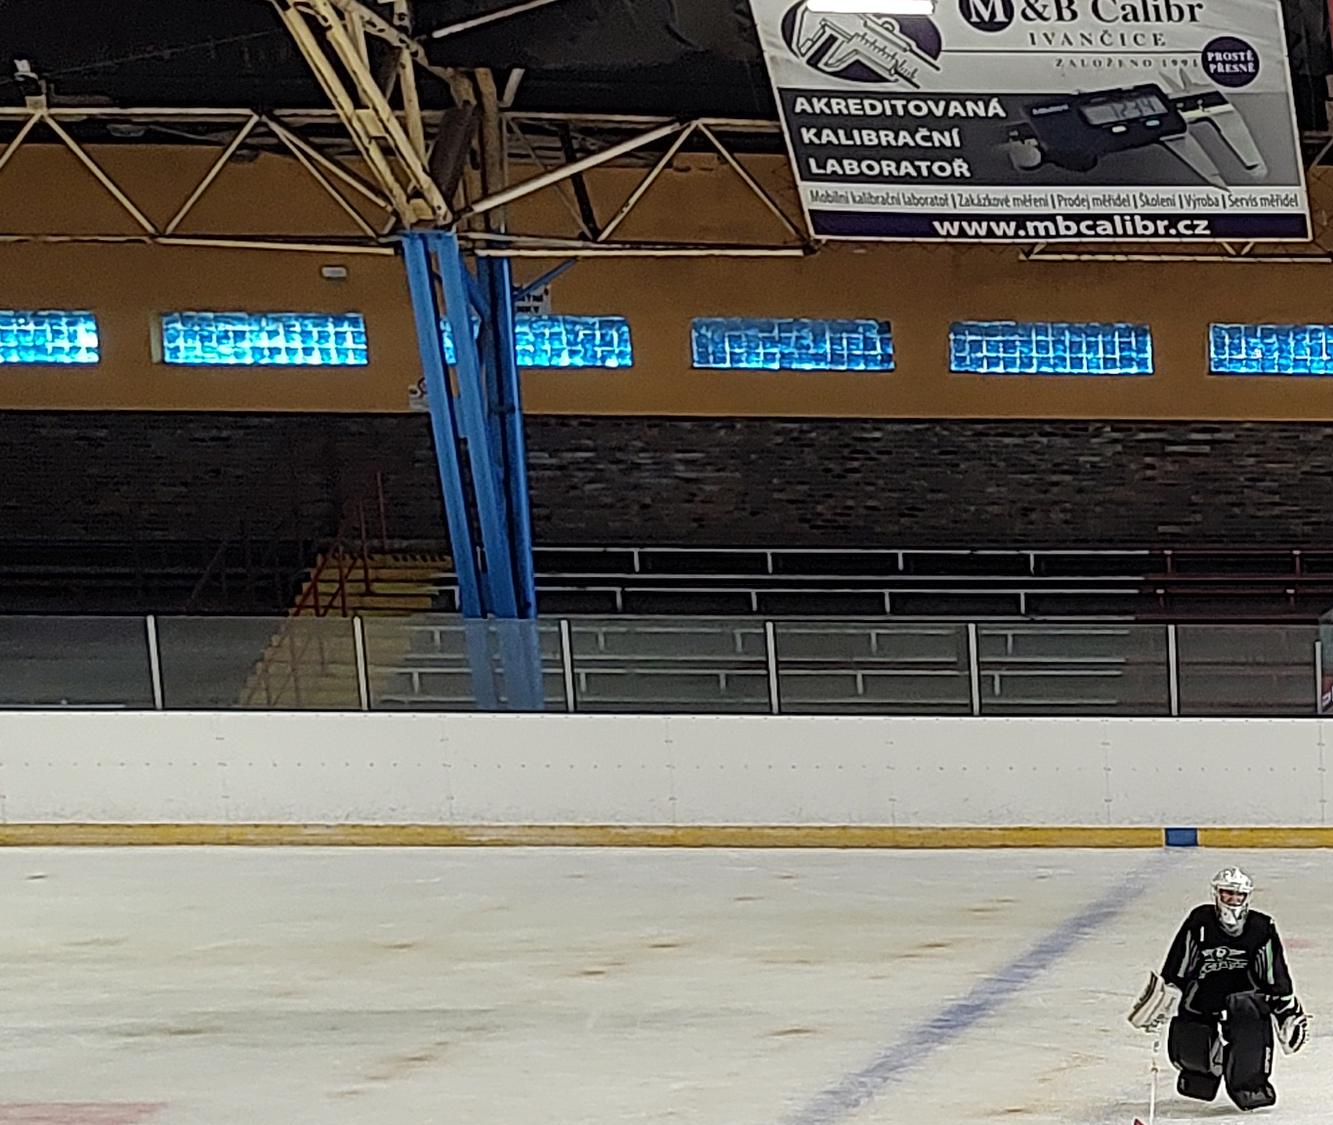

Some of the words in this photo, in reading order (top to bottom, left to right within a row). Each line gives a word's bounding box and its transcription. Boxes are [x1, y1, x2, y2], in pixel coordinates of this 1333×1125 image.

[1028, 30, 1166, 47] IVANČICE
[794, 97, 1007, 118] AKREDITOVANÁ
[801, 127, 961, 147] KALIBRAČNÍ
[808, 157, 972, 177] LABORATOŘ
[933, 214, 1211, 237] www.mbcalibr.cz
